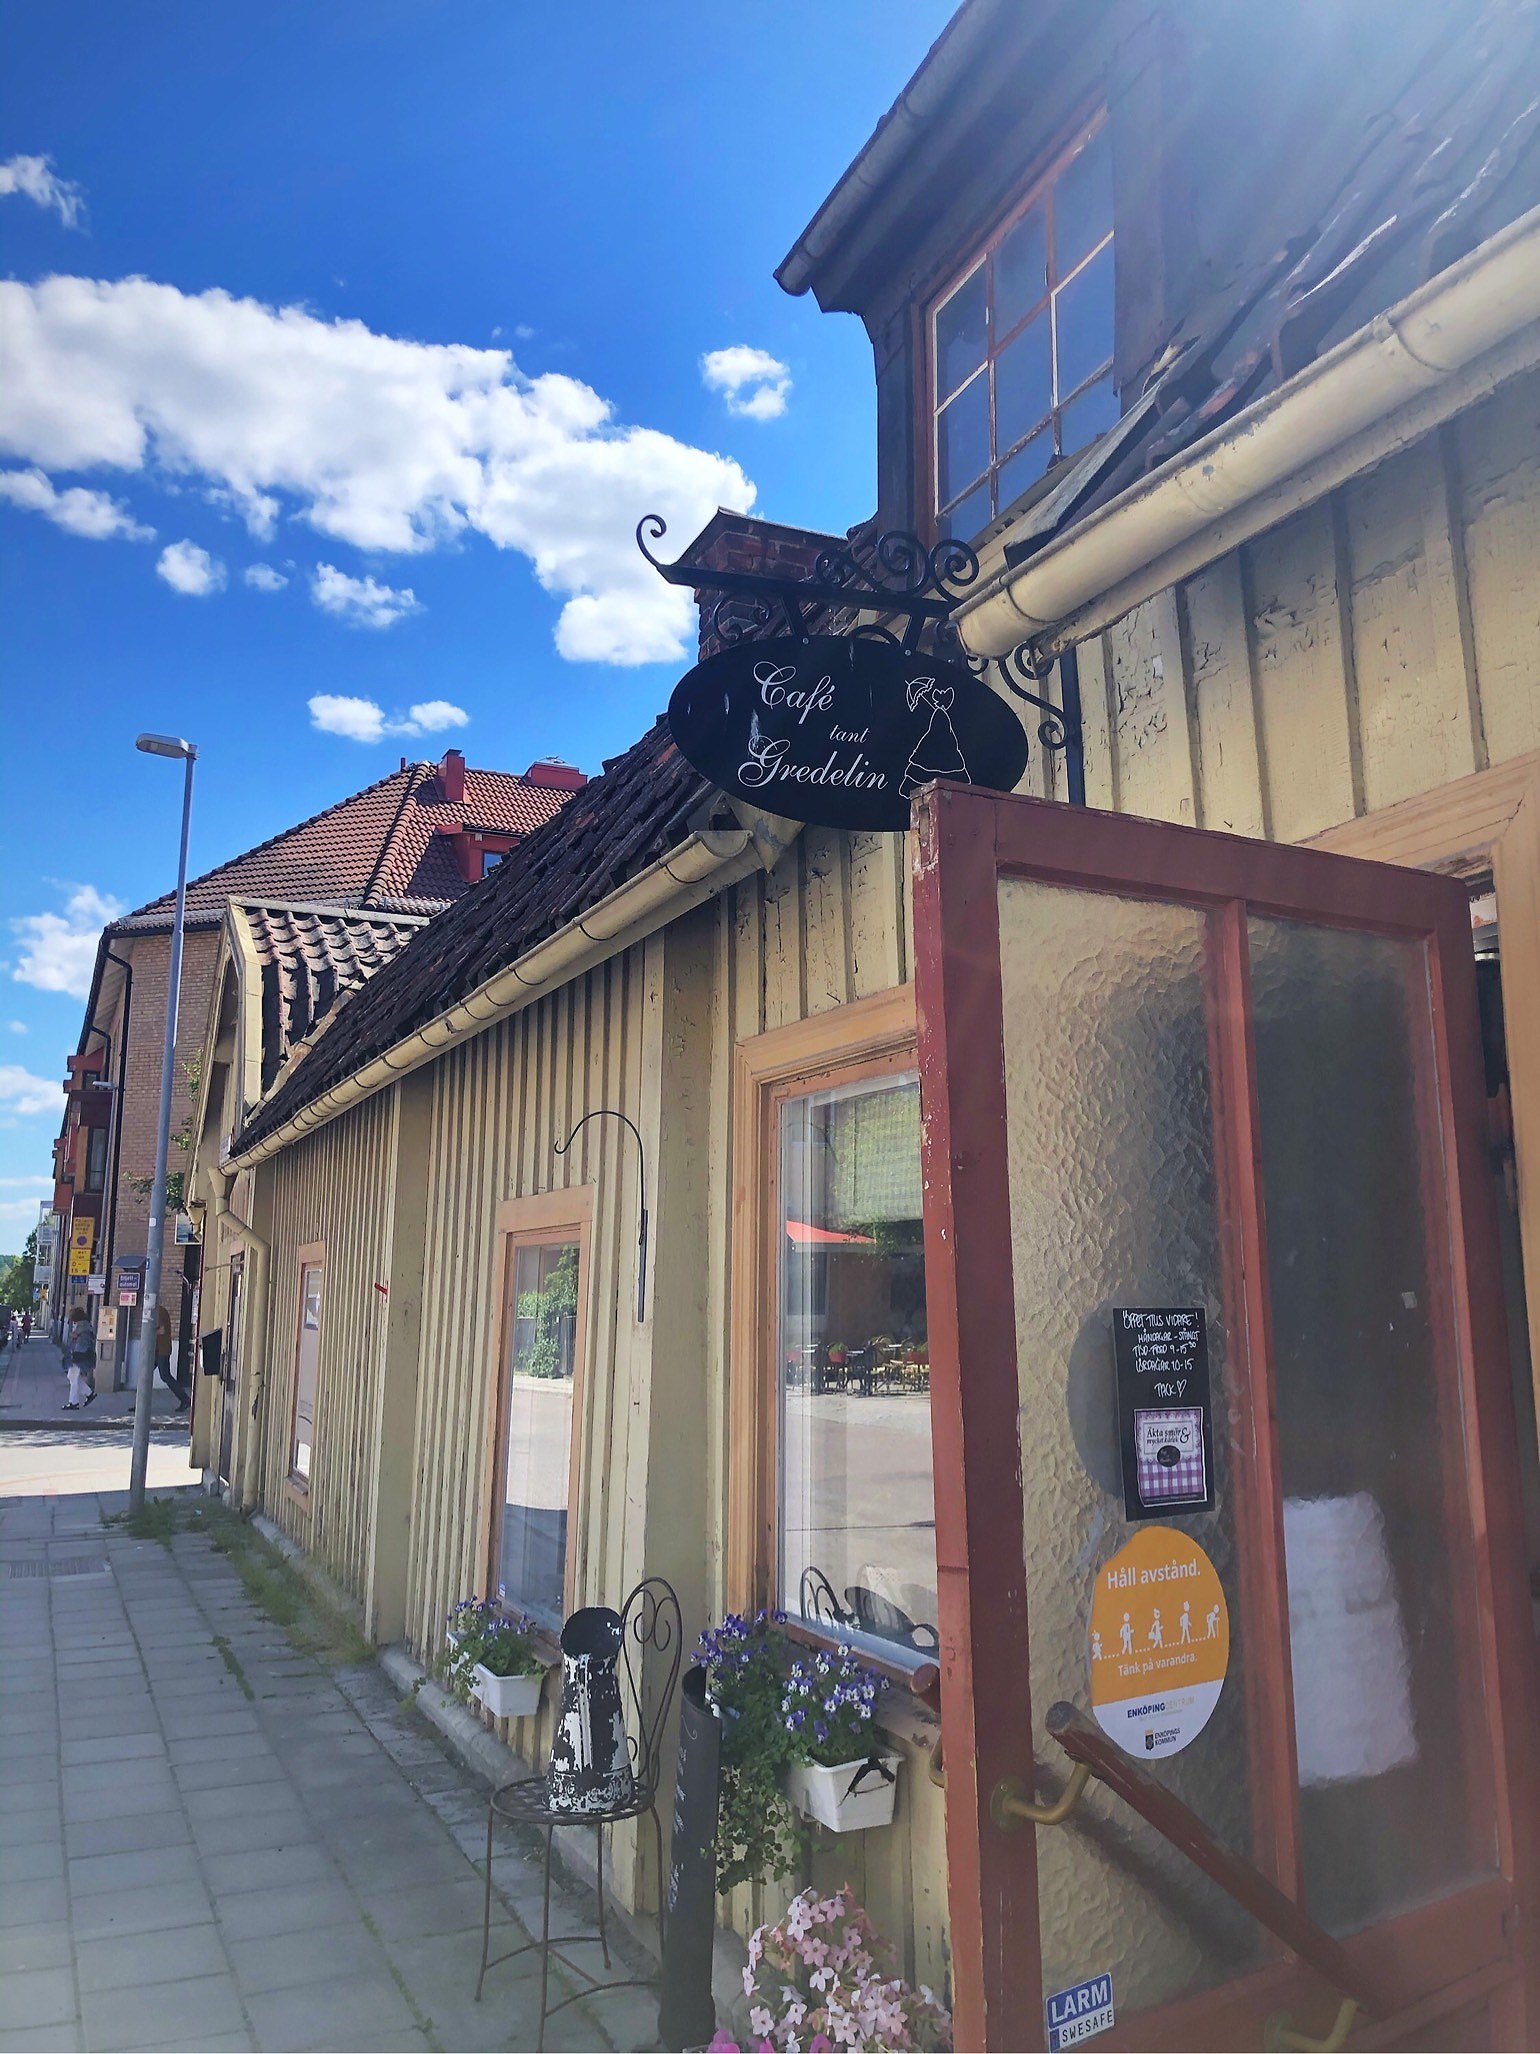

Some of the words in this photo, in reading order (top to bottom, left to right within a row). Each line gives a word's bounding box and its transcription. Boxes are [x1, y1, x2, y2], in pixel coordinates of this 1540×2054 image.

[752, 661, 836, 724] Café
[828, 724, 872, 743] tant
[737, 735, 889, 790] Gredelin
[1154, 1382, 1176, 1397] TACK
[1107, 1567, 1136, 1589] Håll
[1140, 1558, 1201, 1584] avstånd.
[1118, 1661, 1141, 1676] Tänk
[1142, 1659, 1155, 1675] på
[1154, 1727, 1181, 1739] ENKÖPINGS
[1154, 1735, 1177, 1746] KOMMUN
[1051, 1980, 1108, 2023] LARM
[1061, 2009, 1113, 2043] SWESAFE
